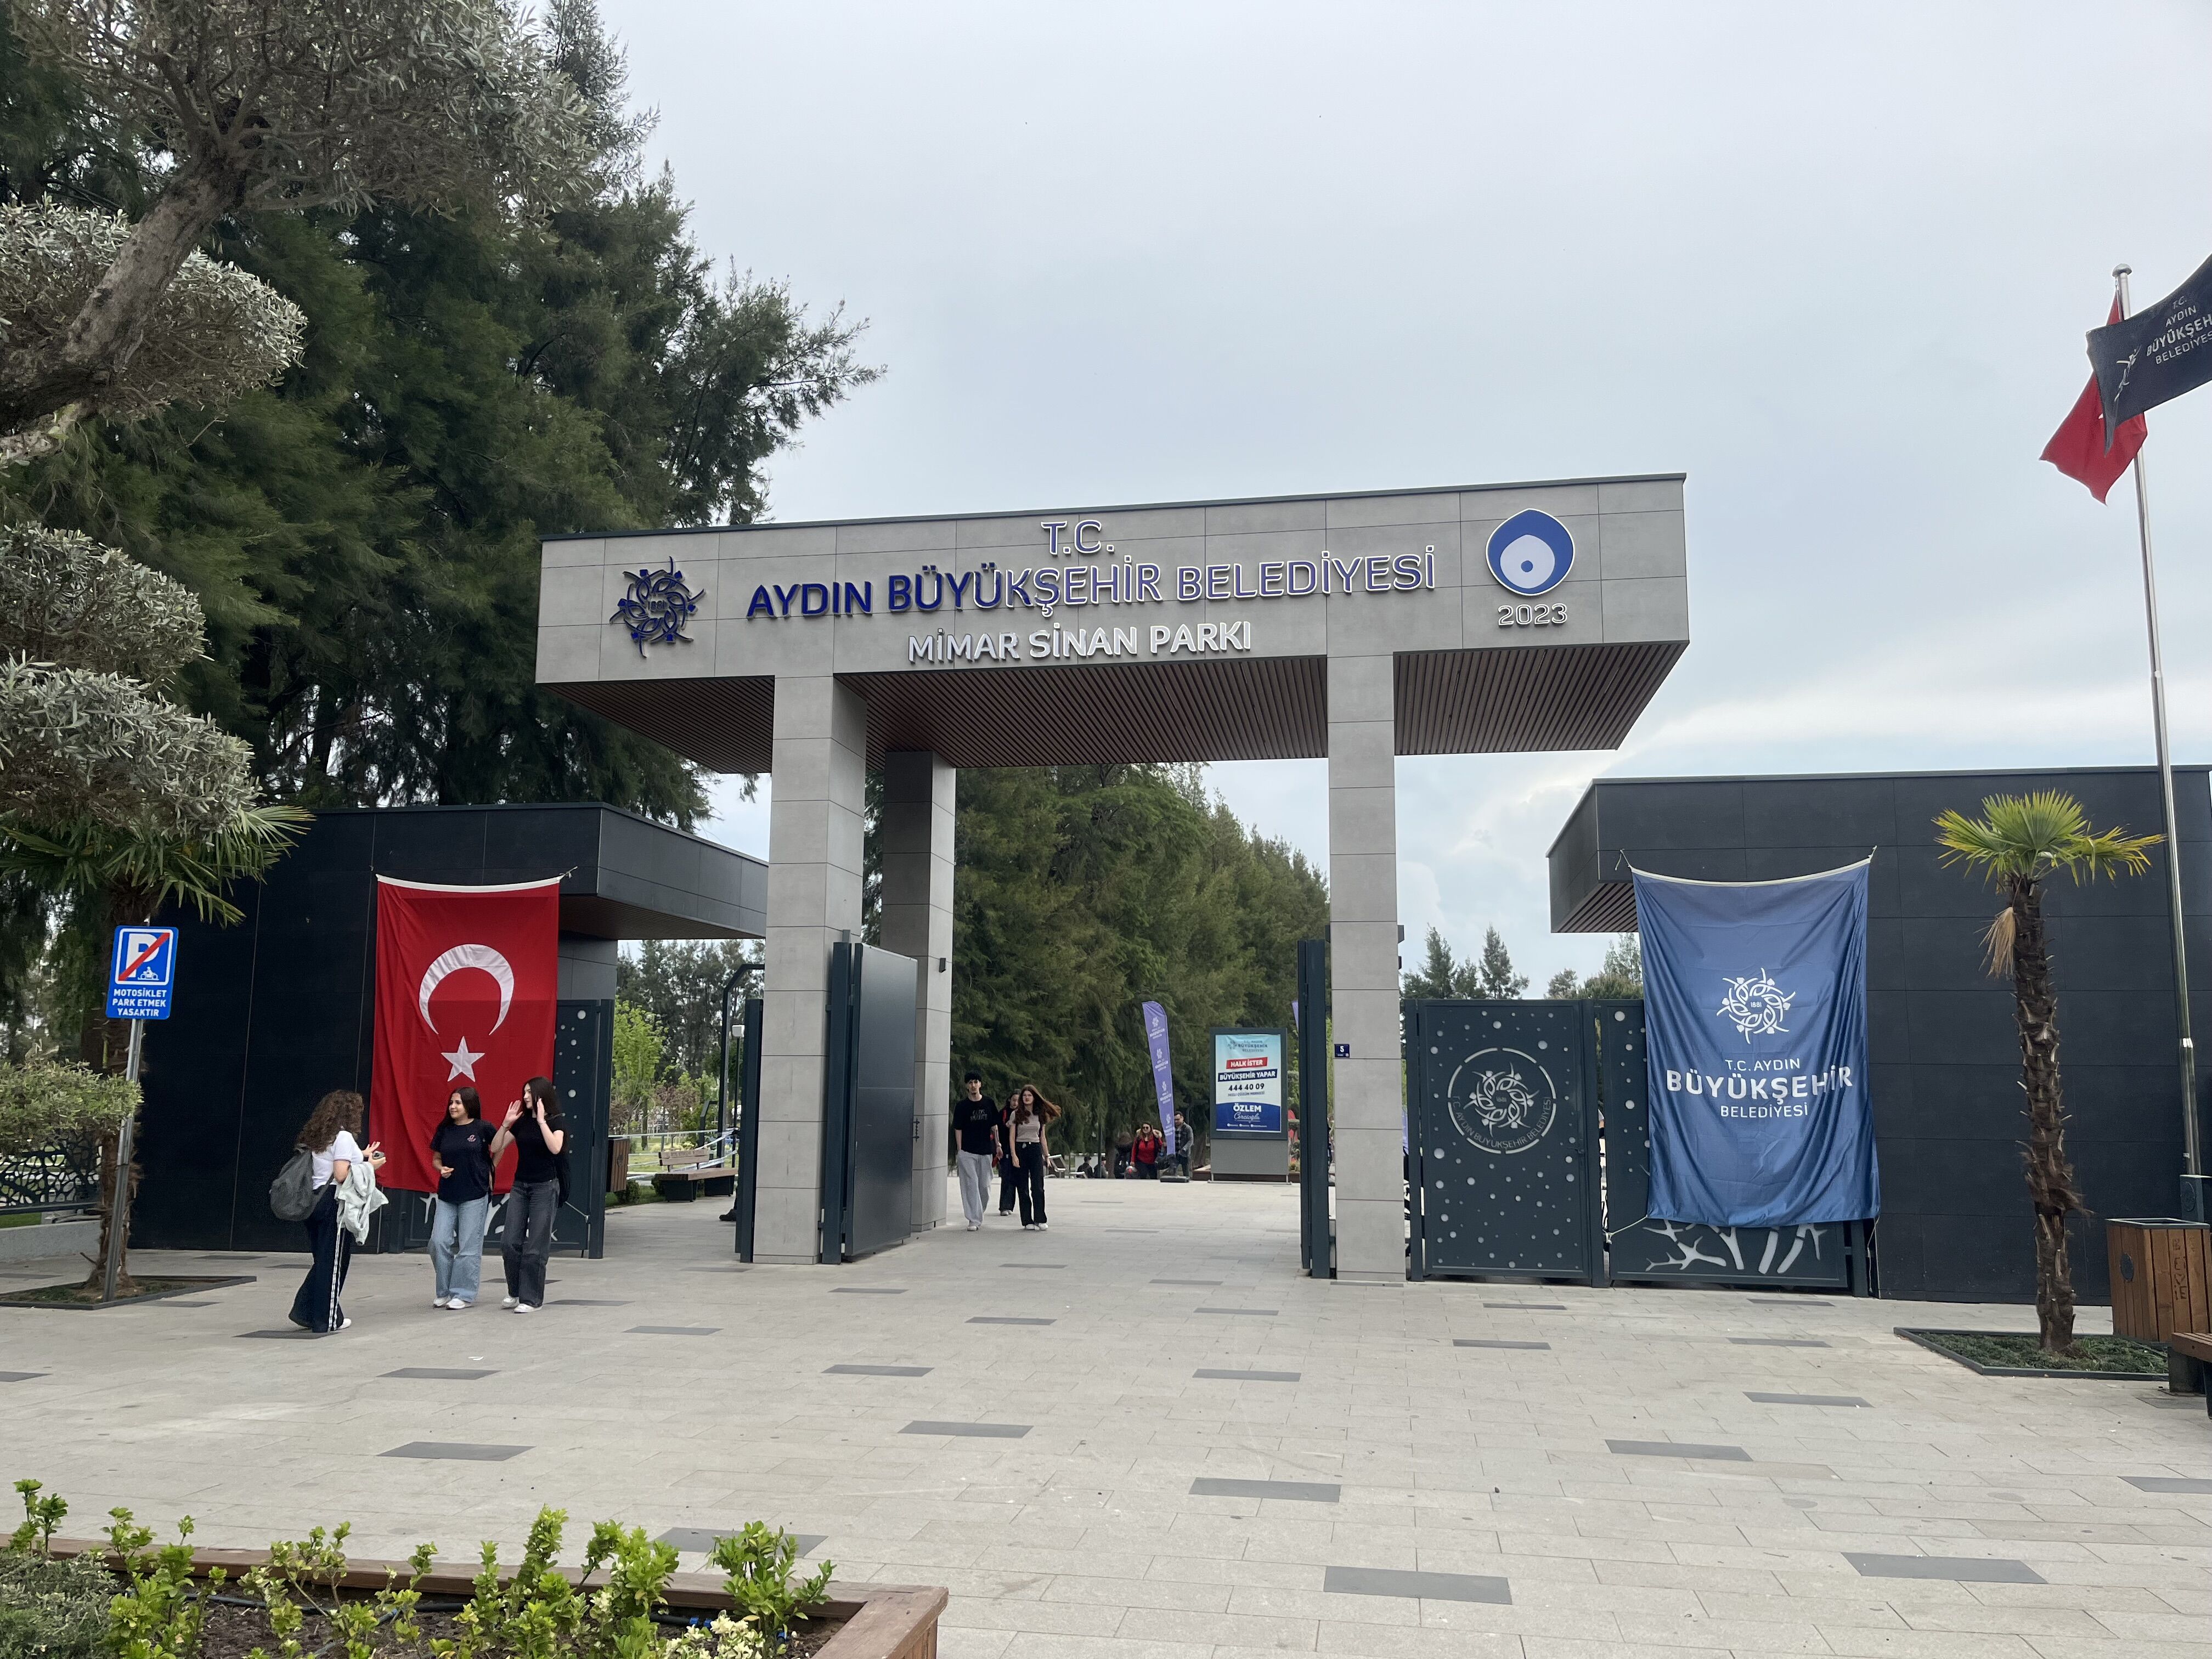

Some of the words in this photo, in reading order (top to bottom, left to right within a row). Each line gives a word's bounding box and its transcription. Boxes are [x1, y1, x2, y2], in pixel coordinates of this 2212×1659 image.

[2173, 296, 2187, 309] T.C.
[2165, 305, 2196, 328] AYDIN
[1041, 520, 1114, 555] T.C.
[746, 581, 872, 619] AYDIN
[888, 554, 1163, 618] BÜYÜKŞEHİR
[1177, 545, 1435, 601] BELEDİYESİ
[1498, 603, 1567, 627] 2023
[909, 628, 1020, 663] MİMAR
[1029, 622, 1138, 658] SİNAN
[1150, 621, 1251, 654] PARKI
[114, 988, 167, 997] MOTOSİKLET
[137, 999, 166, 1007] ETMEK
[117, 1008, 159, 1017] YASAKTIR
[1725, 1059, 1751, 1071] T.C.
[1754, 1058, 1800, 1071] AYDIN
[1220, 1071, 1255, 1081] BÜYÜKŞEHİR
[1666, 1065, 1853, 1104] BÜYÜKŞEHİR
[1233, 1103, 1261, 1112] ÖZLEM
[1720, 1101, 1808, 1118] BELEDİYESİ
